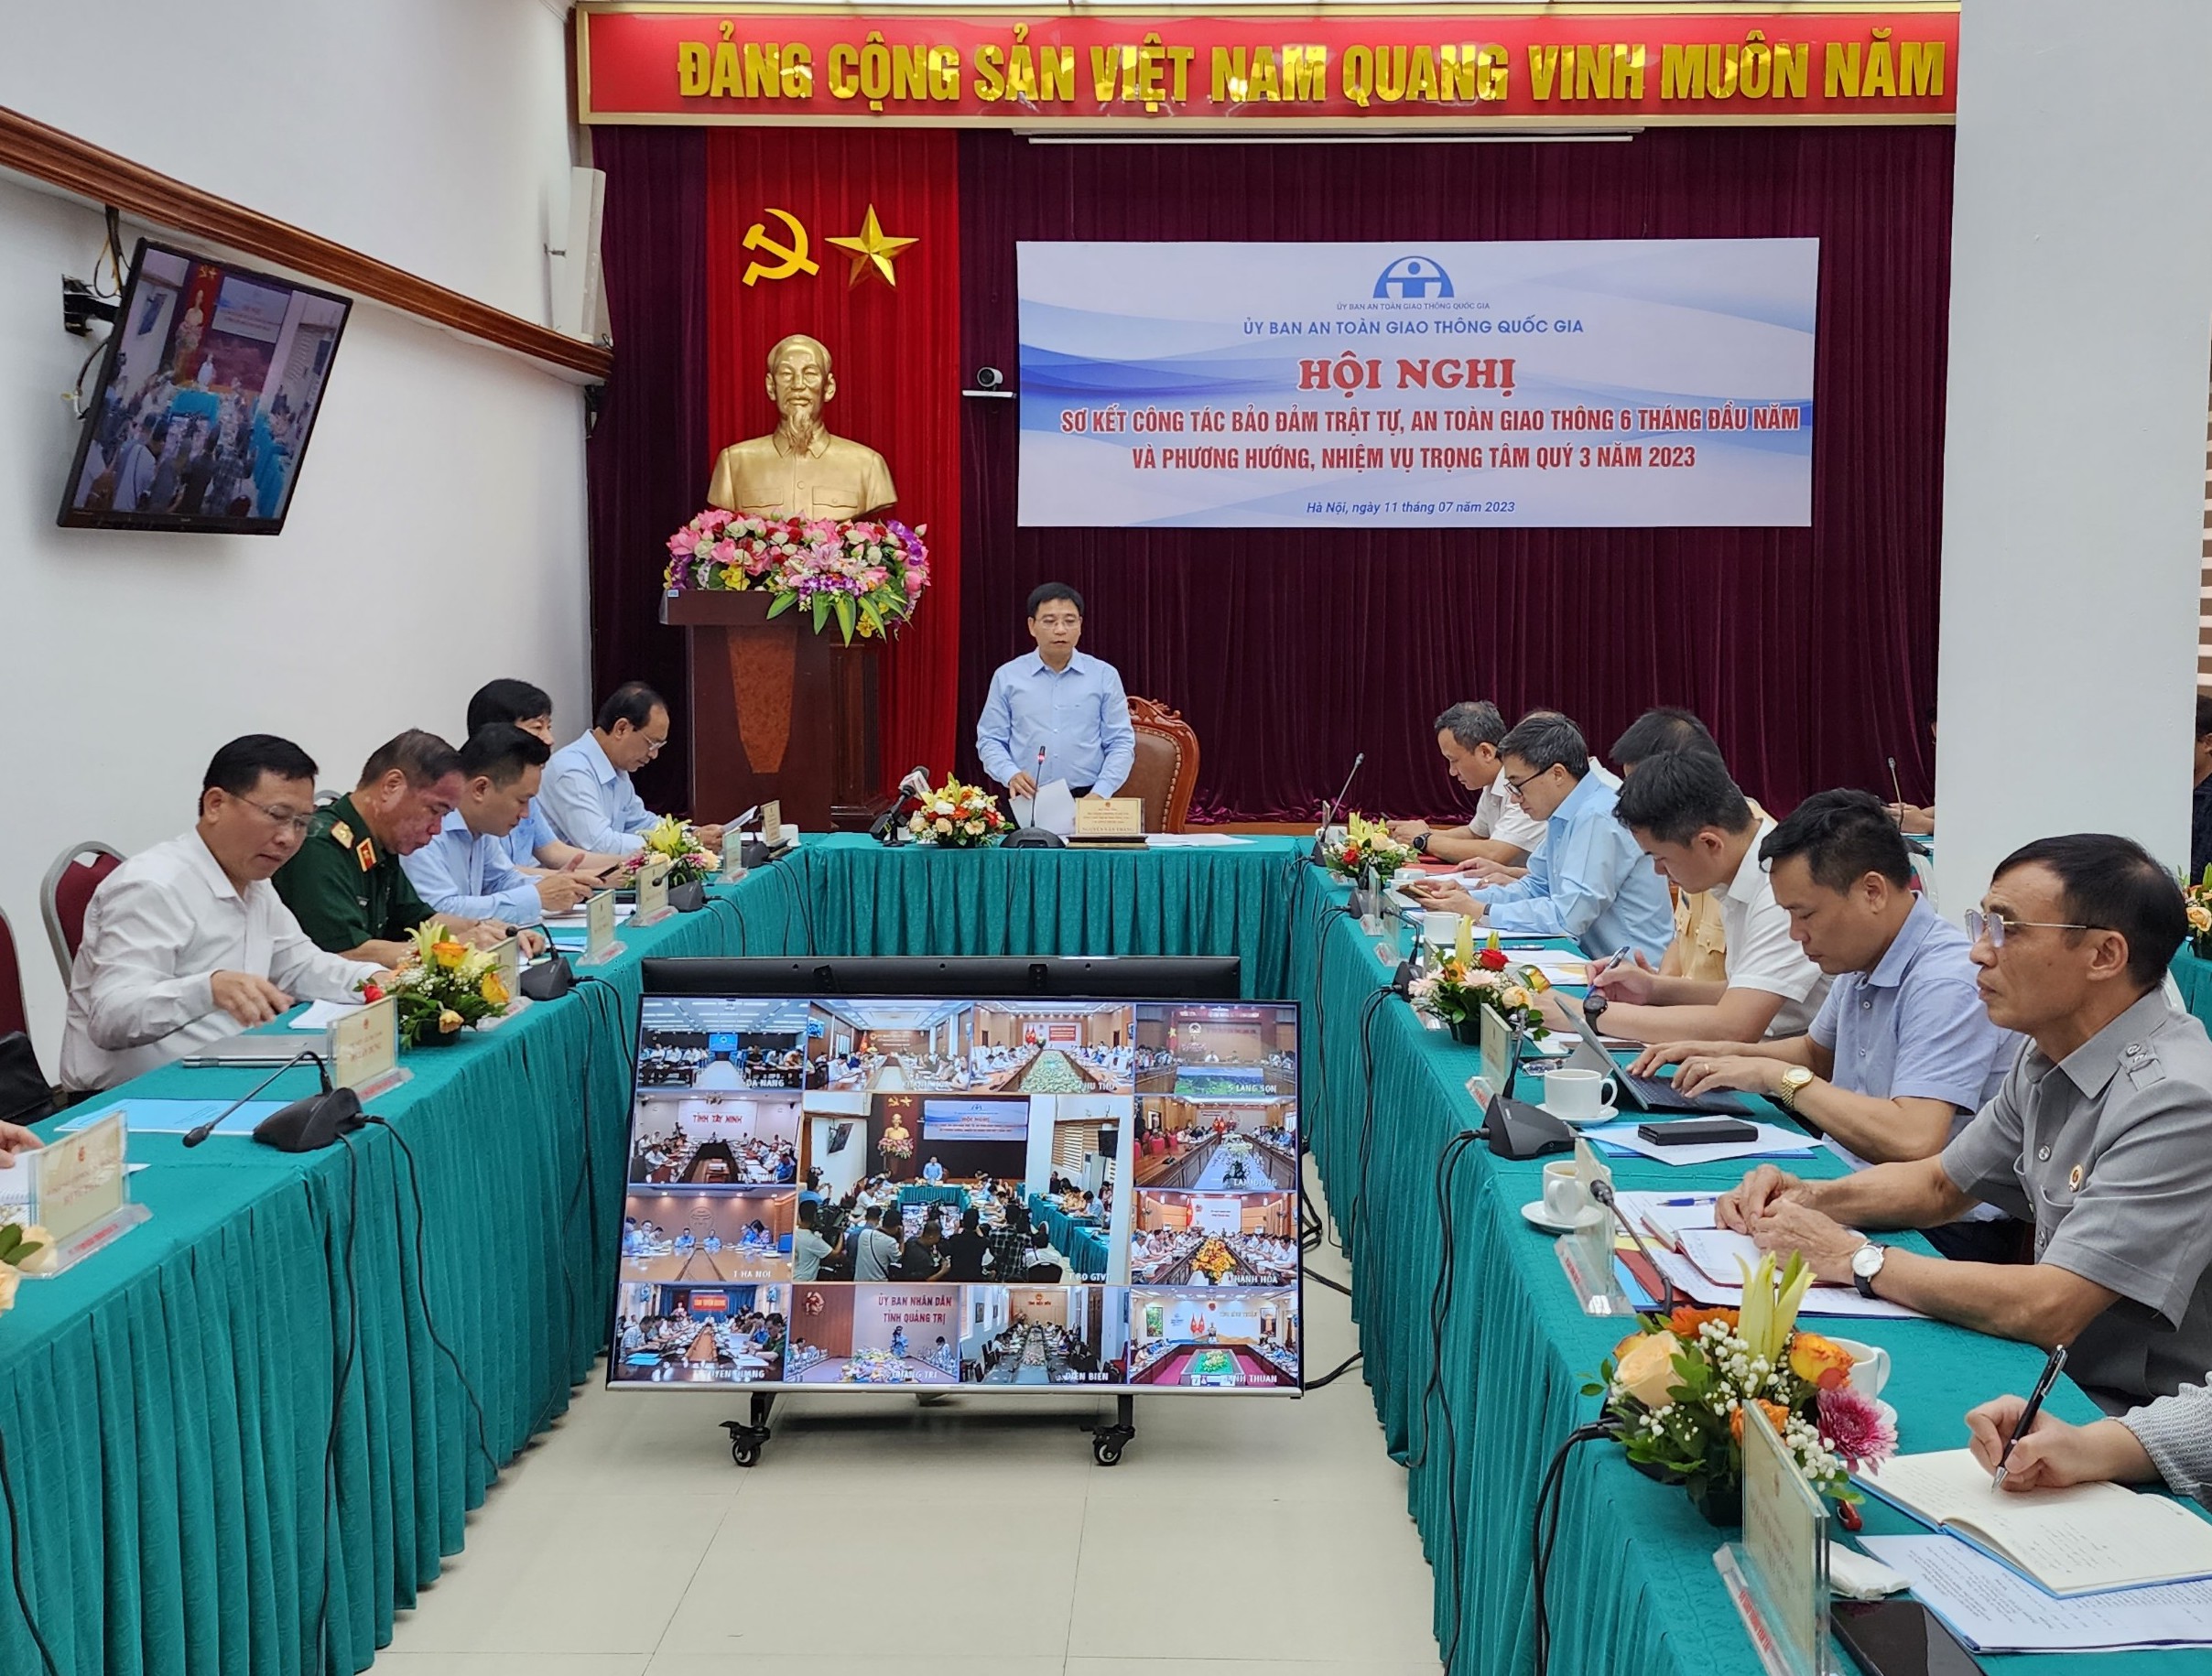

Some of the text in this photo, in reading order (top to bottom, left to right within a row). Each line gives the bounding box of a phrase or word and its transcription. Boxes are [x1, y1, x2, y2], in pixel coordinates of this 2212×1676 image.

[678, 21, 1945, 112] ĐẢNG CỘNG SẢN VIỆT NAM QUANG VINH MUÔN NĂM
[1243, 314, 1583, 335] ỦY BAN AN TOÀN GIAO THÔNG QUỐC GIA
[1298, 351, 1516, 398] HỘI NGHỊ
[1062, 400, 1799, 437] SƠ KẾT CÔNG TÁC BẢO ĐẢM TRẬT TỰ, AN TOÀN GIAO THÔNG 6 THÁNG ĐẦU NĂM
[1133, 442, 1696, 473] VÀ PHƯƠNG HƯỚNG, NHIỆM VỤ TRỌNG TÂM QUÝ 3 NĂM 2023
[1307, 500, 1515, 515] Hà Nội, ngày 11 tháng 07 năm 2023
